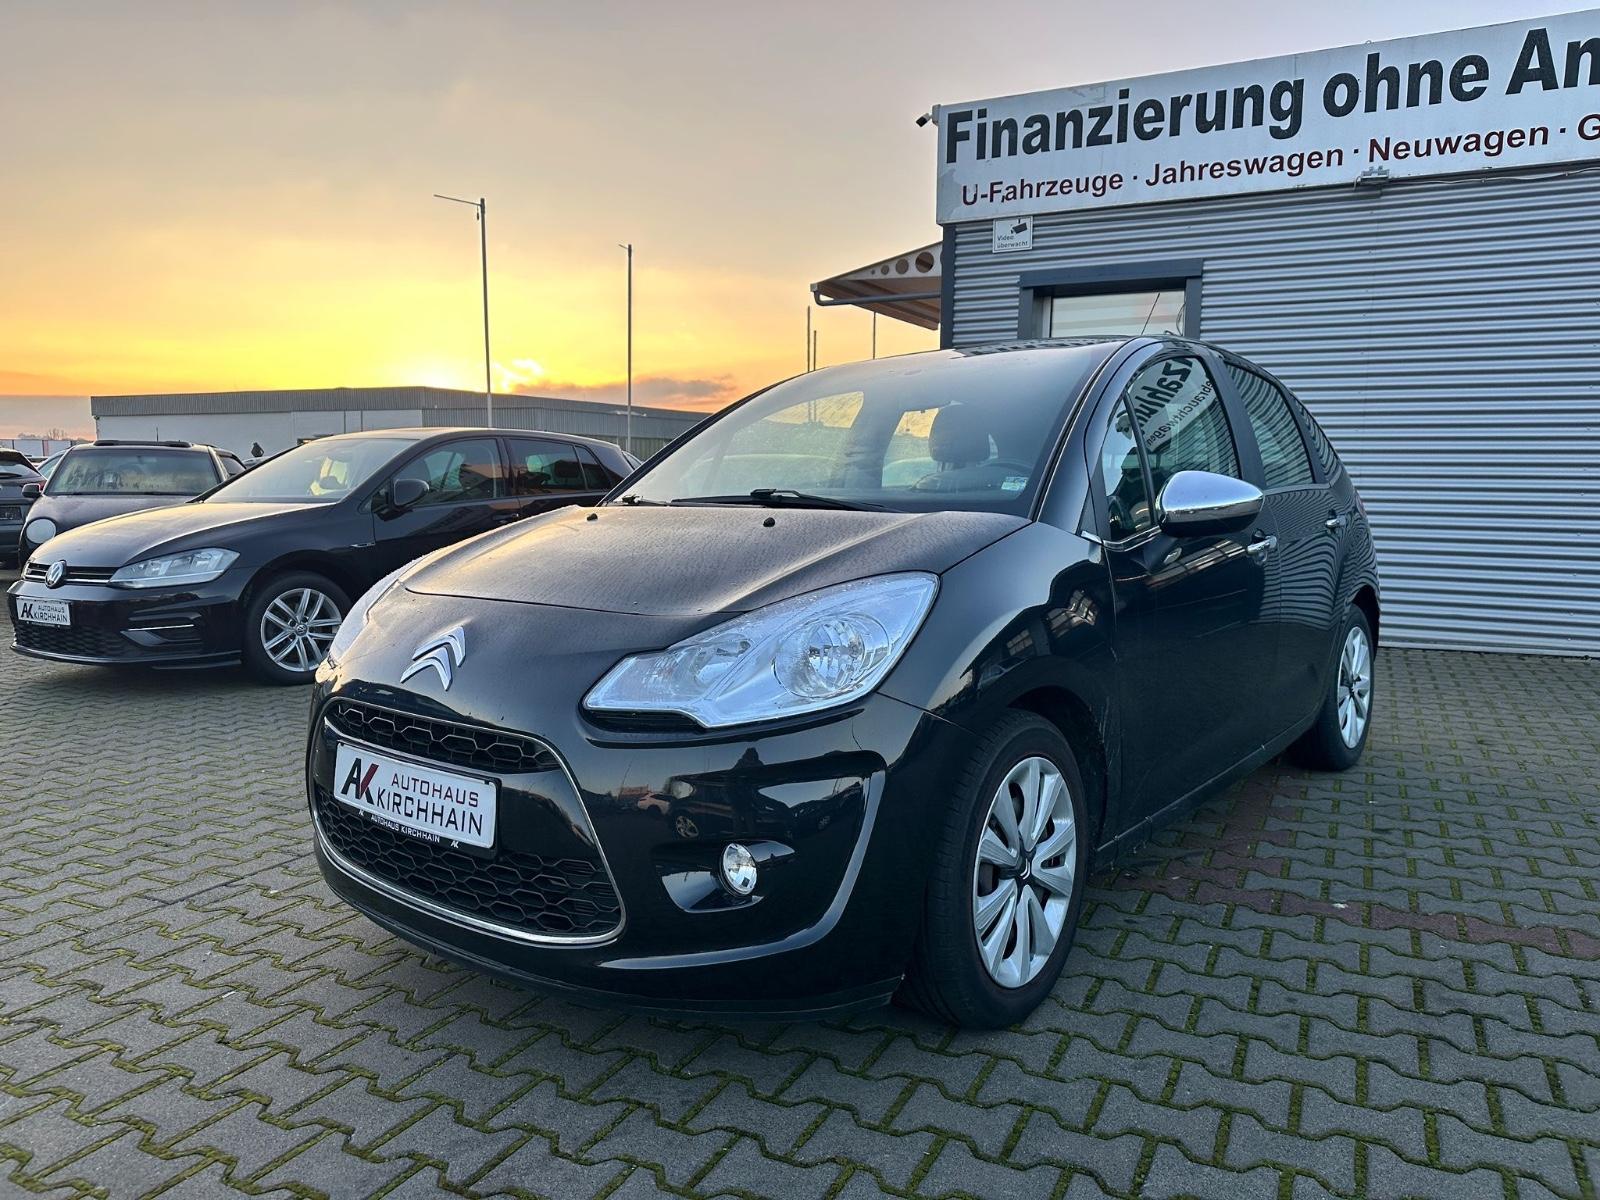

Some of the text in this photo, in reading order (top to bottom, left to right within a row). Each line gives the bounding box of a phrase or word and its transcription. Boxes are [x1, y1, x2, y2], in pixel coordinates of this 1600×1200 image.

[946, 78, 1304, 164] Finanzierung
[1323, 53, 1489, 117] ohne
[963, 171, 1124, 206] U-Fahrzeuge
[1146, 148, 1343, 187] Jahreswagen
[1369, 126, 1549, 163] Neuwagen
[33, 611, 68, 622] KIRCHHAIN
[38, 605, 65, 613] AUTOHAUS
[341, 758, 379, 804] AK
[391, 773, 479, 808] AUTOHAUS
[371, 814, 399, 832] AUTOHAUS
[401, 826, 440, 843] KIRCHHAIN
[377, 787, 483, 836] KIRCHHAIN
